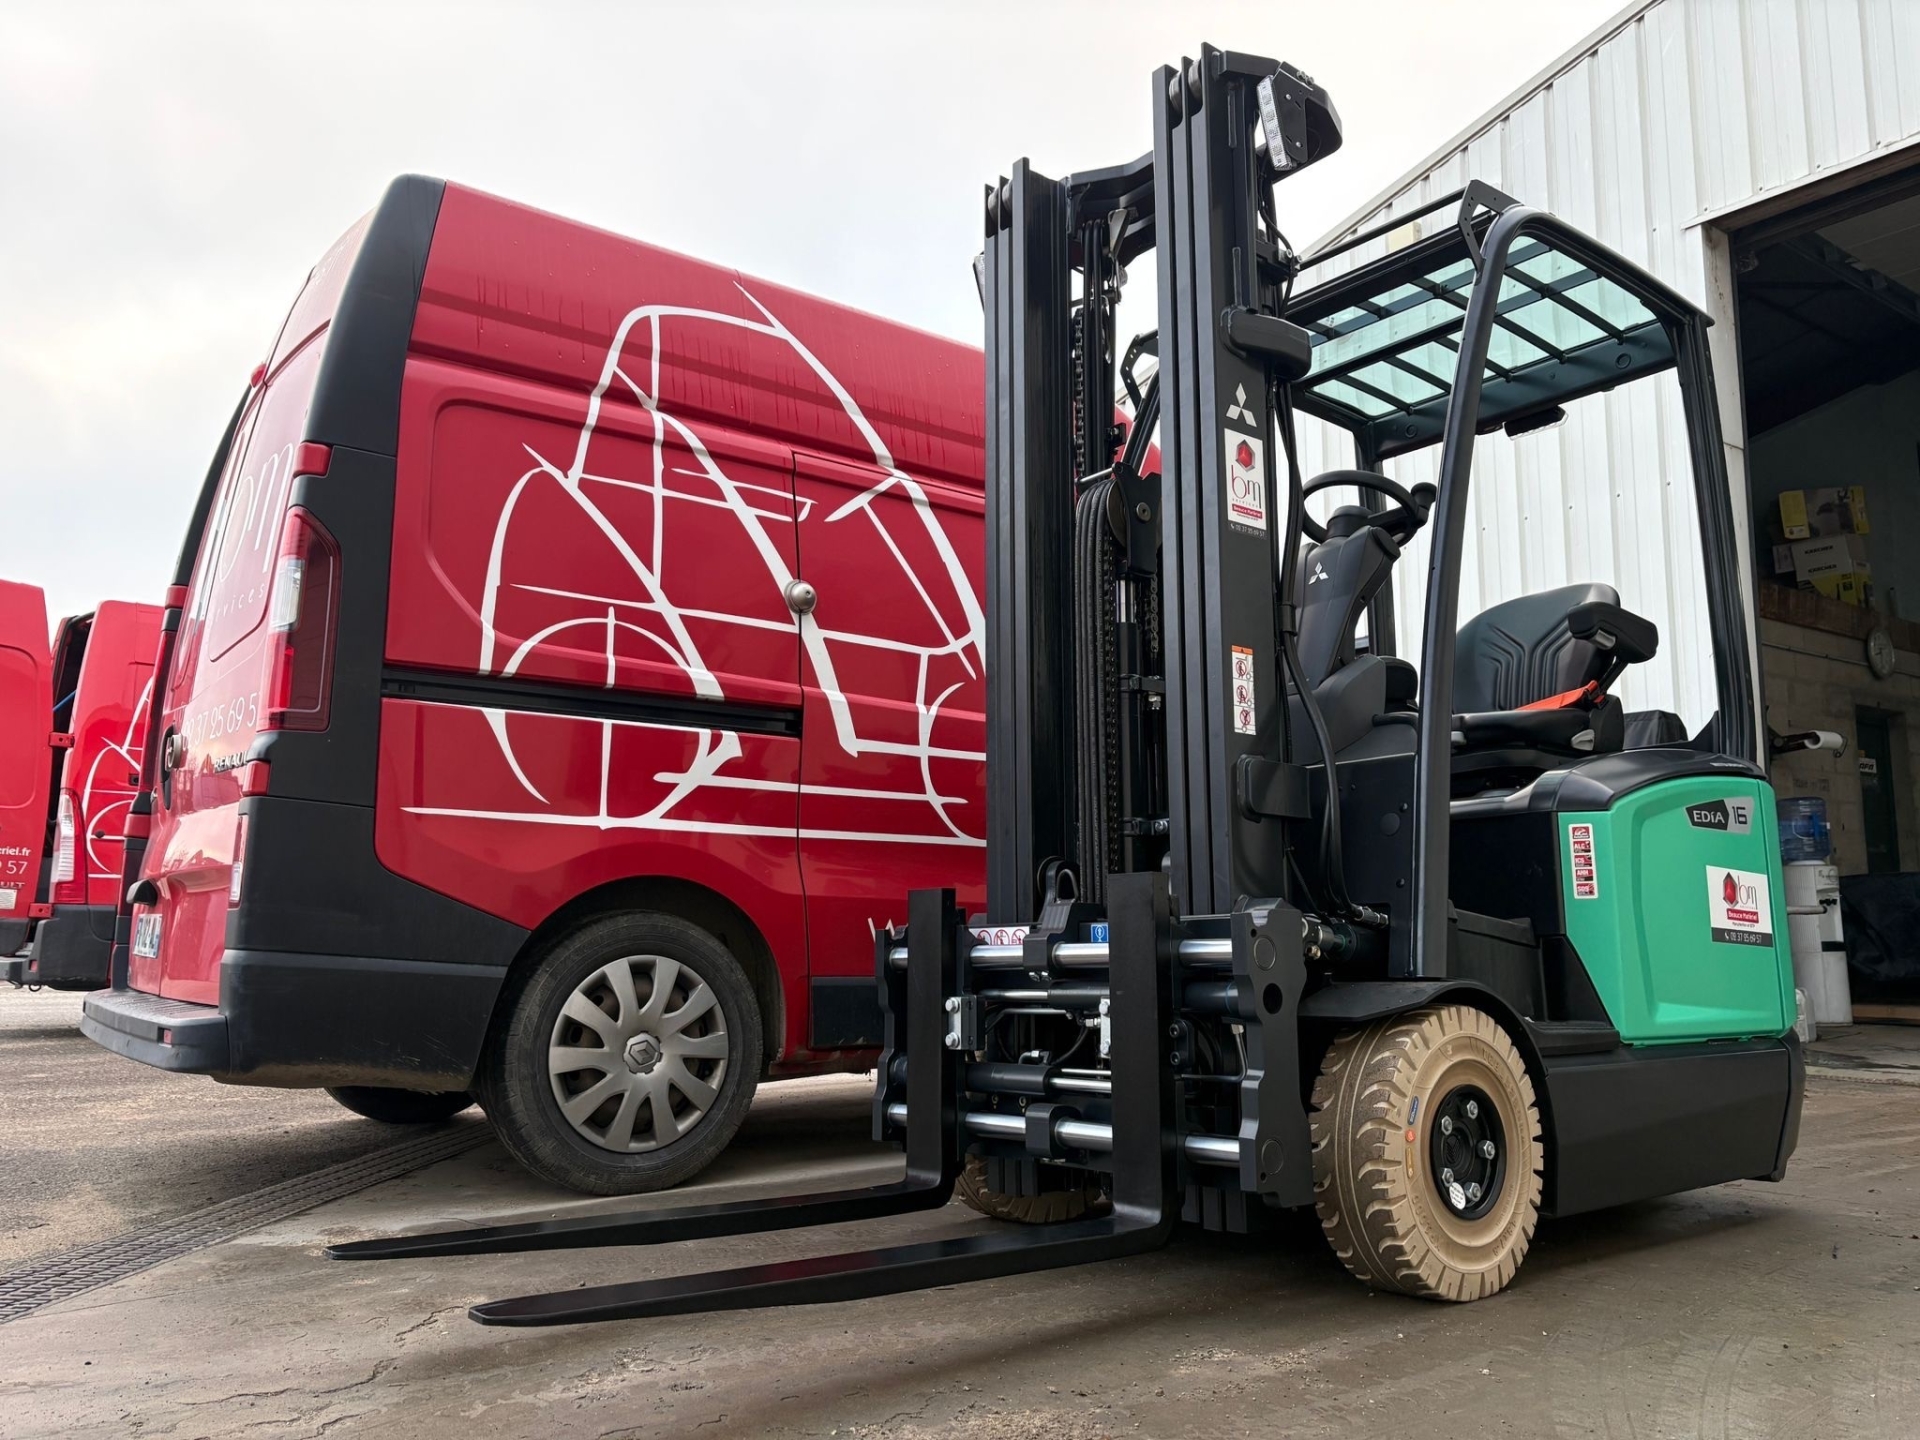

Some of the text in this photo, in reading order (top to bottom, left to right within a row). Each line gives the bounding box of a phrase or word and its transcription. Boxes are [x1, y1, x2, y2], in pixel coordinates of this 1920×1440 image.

[1231, 464, 1262, 509] bm
[195, 710, 209, 745] 37
[226, 696, 245, 734] 69
[247, 692, 260, 728] 5
[214, 751, 248, 773] RENAUL
[1731, 805, 1748, 825] 16
[6, 860, 28, 875] 57
[1737, 932, 1743, 942] 37
